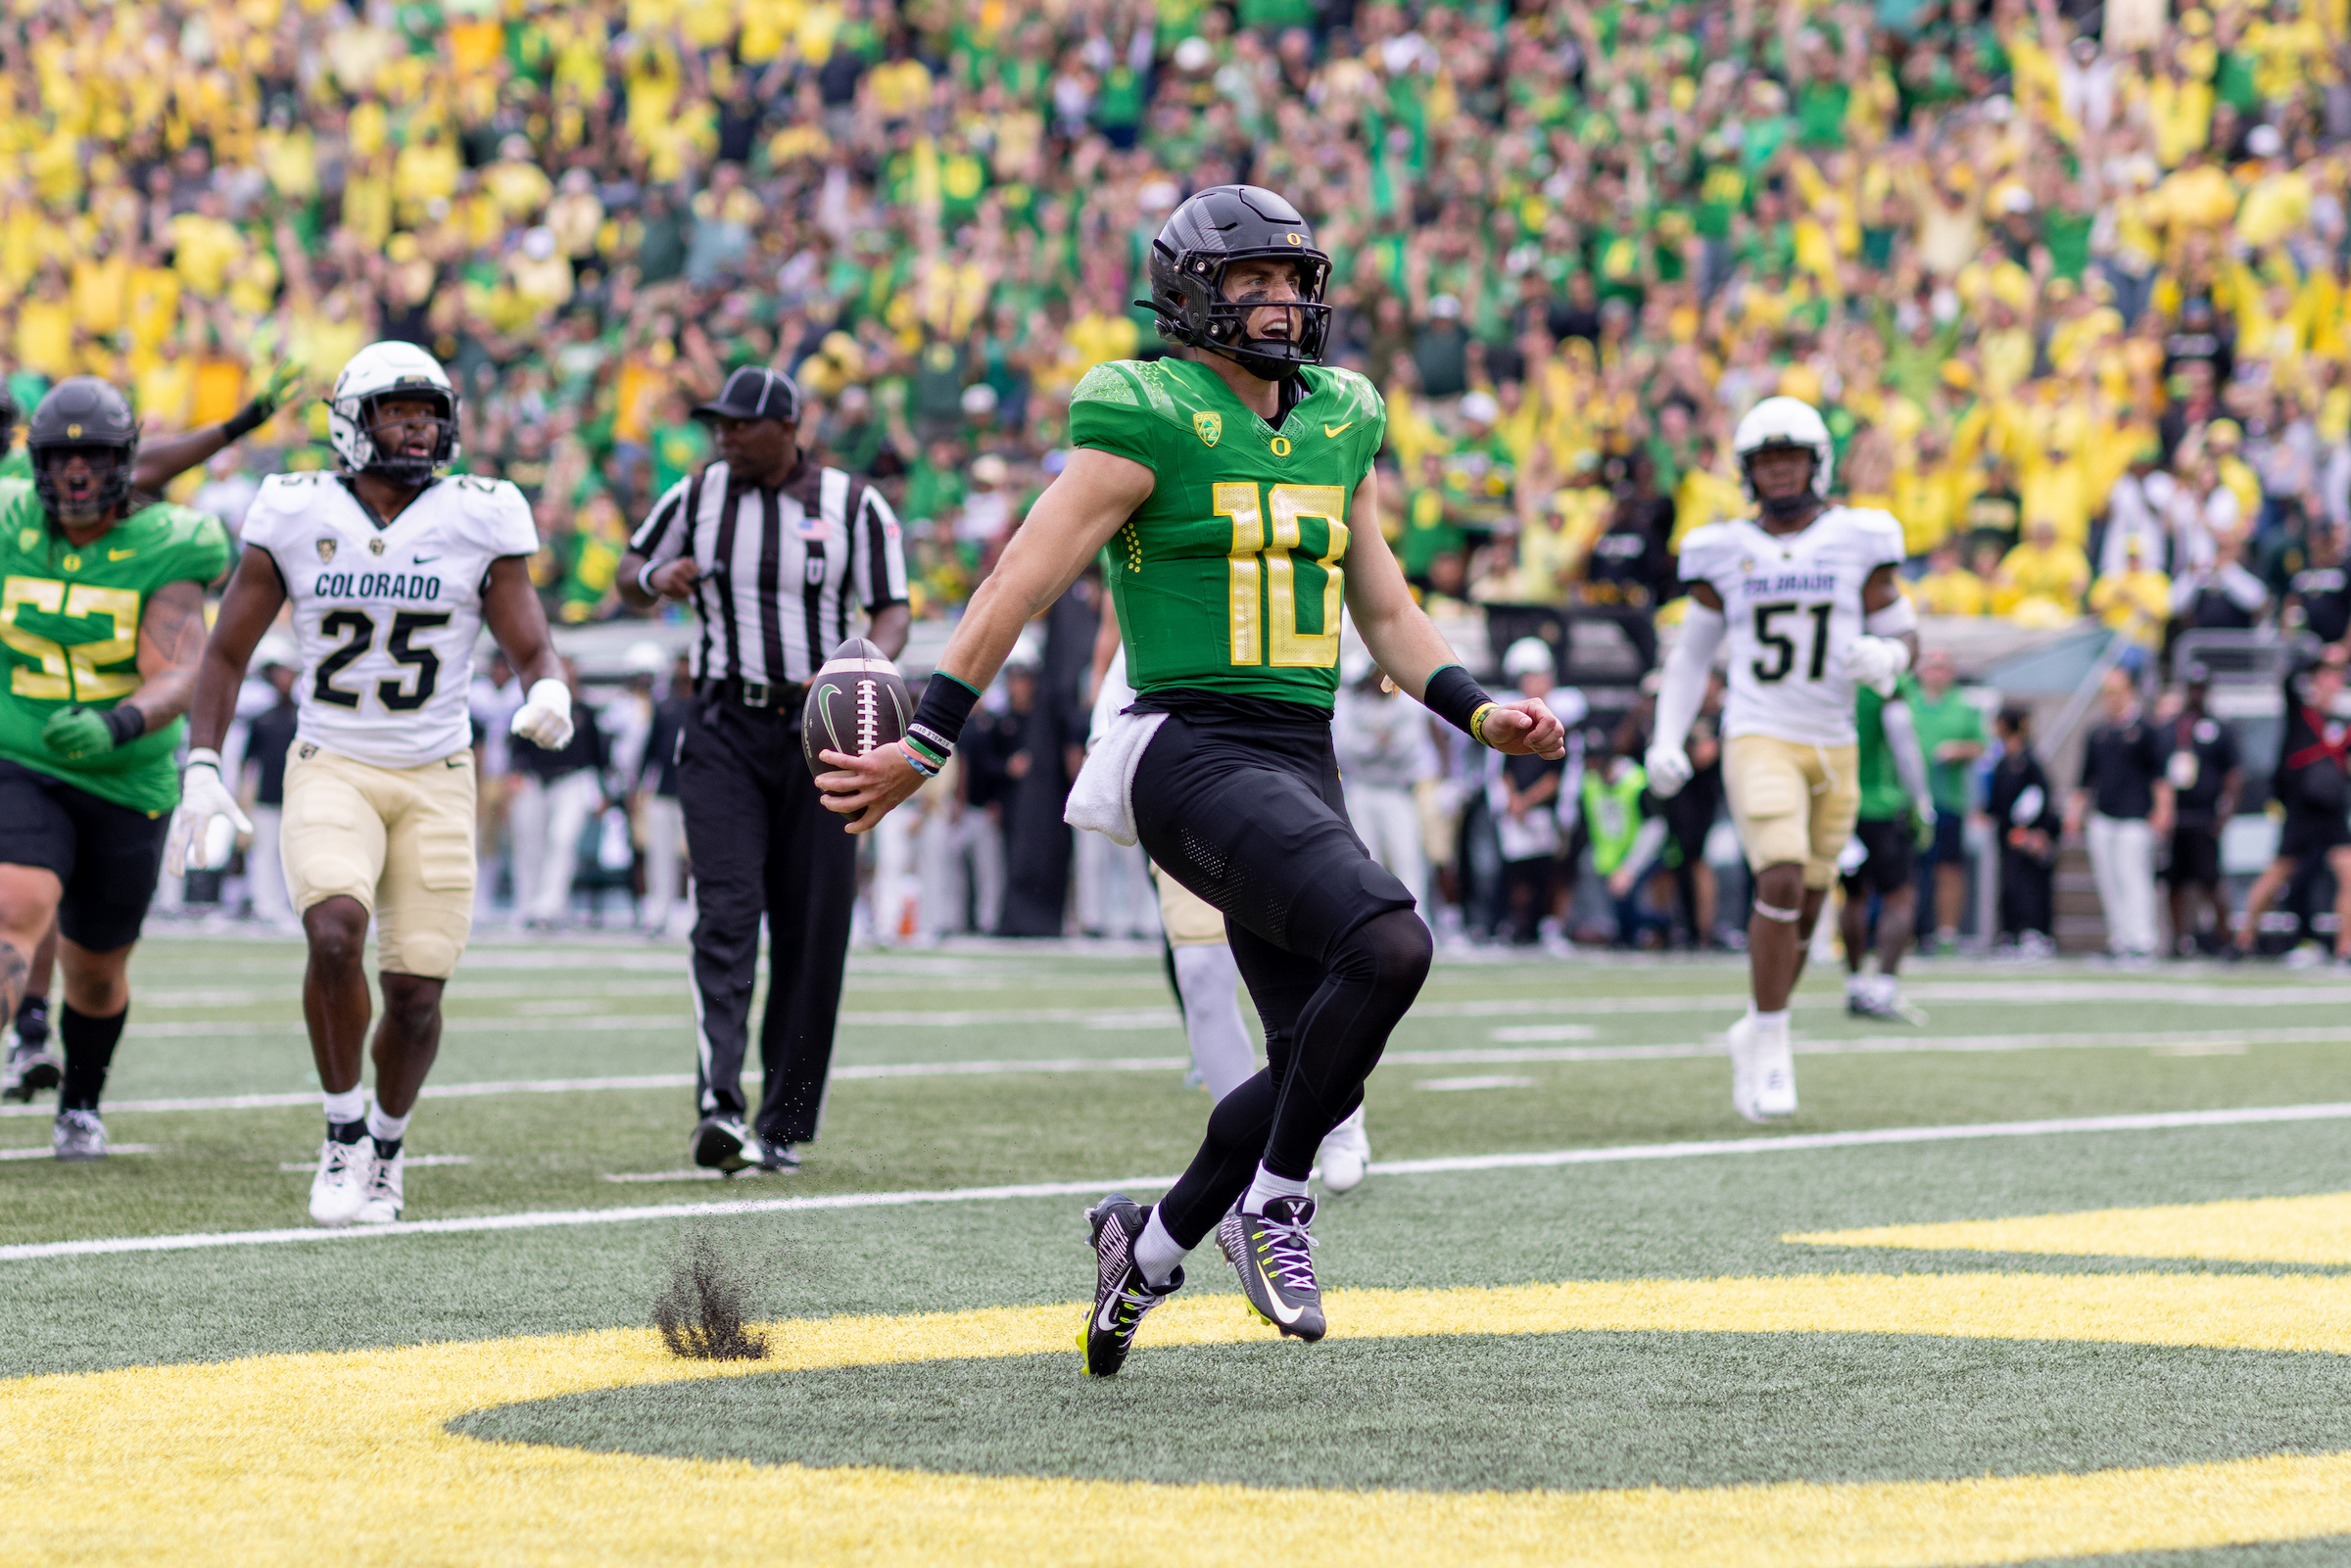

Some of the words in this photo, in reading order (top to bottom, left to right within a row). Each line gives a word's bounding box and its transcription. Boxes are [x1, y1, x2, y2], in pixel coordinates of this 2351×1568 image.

[1286, 232, 1301, 246] O
[1195, 412, 1221, 431] PAC
[1203, 426, 1219, 440] 12
[1271, 437, 1291, 457] O
[806, 558, 824, 586] U
[1213, 482, 1349, 668] 10
[314, 572, 441, 601] COLORADO
[0, 575, 143, 702] 52
[1751, 600, 1836, 685] 51
[312, 607, 455, 714] 25
